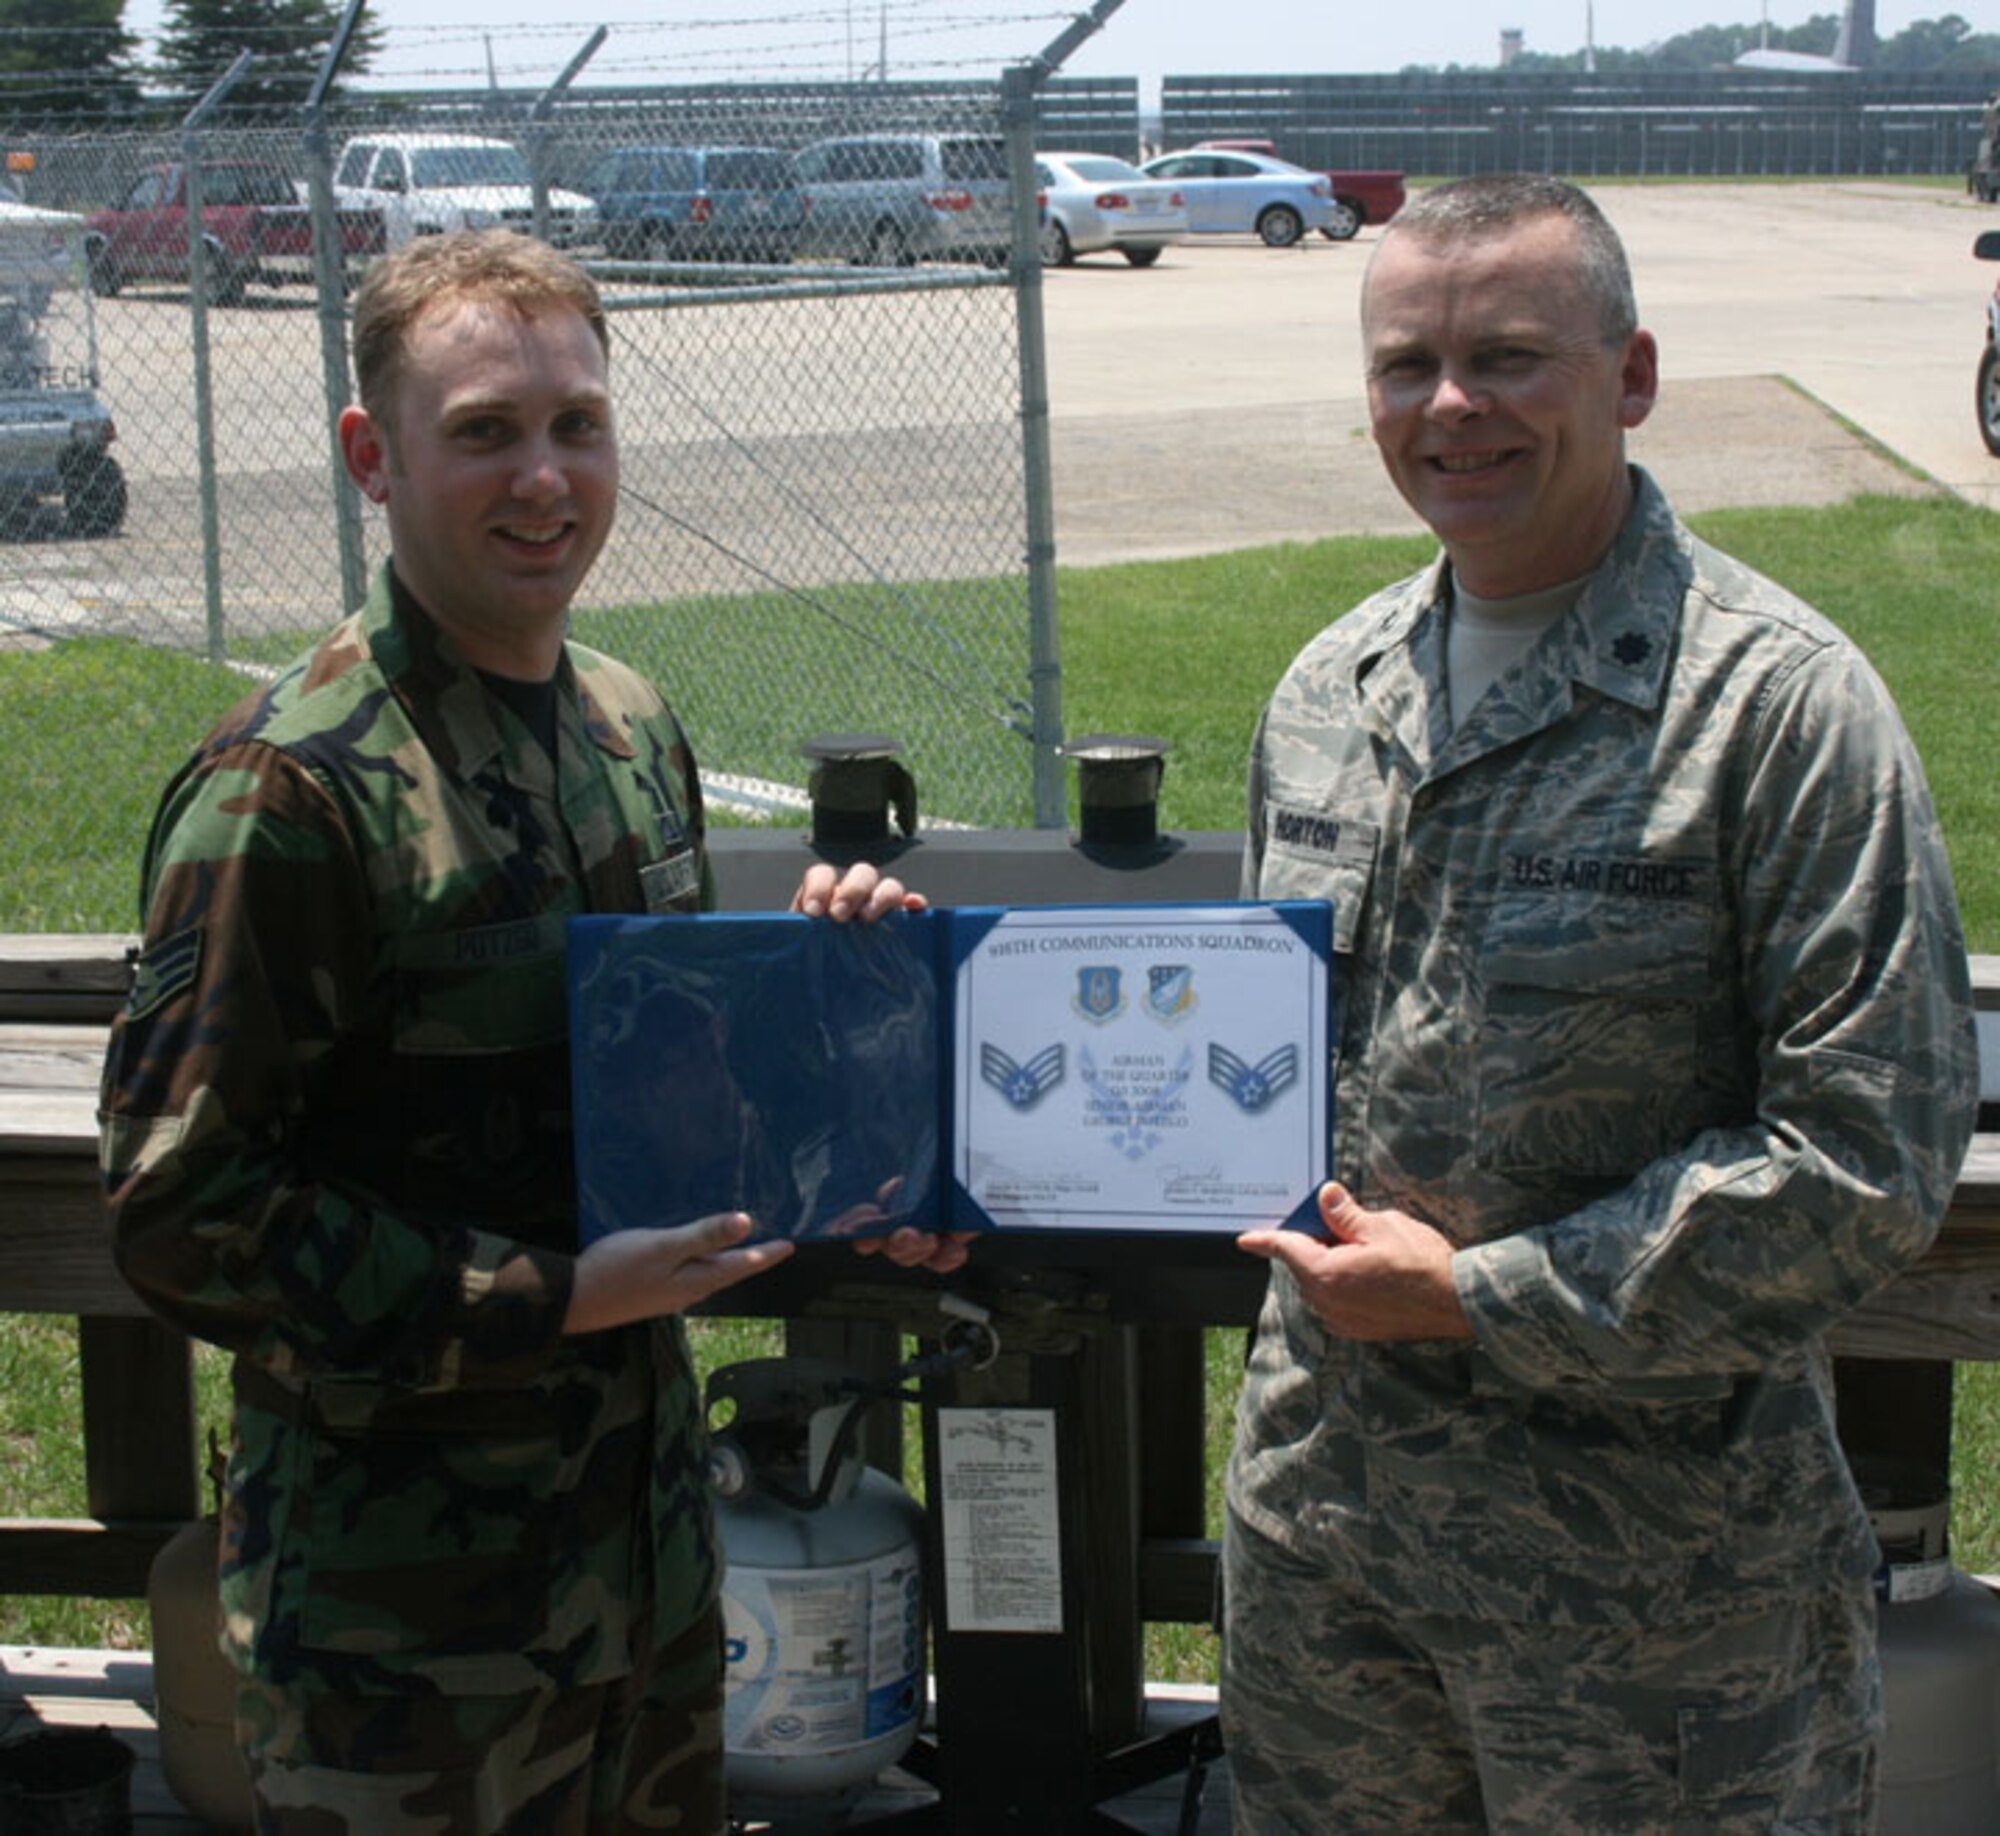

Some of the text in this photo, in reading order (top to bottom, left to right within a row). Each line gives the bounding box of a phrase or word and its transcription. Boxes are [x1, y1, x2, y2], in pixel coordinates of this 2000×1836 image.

[1561, 859, 1600, 891] AIR
[1607, 862, 1699, 898] FORCE
[1039, 934, 1195, 952] COMMUNICATIONS
[1198, 934, 1294, 953] SQUADRON
